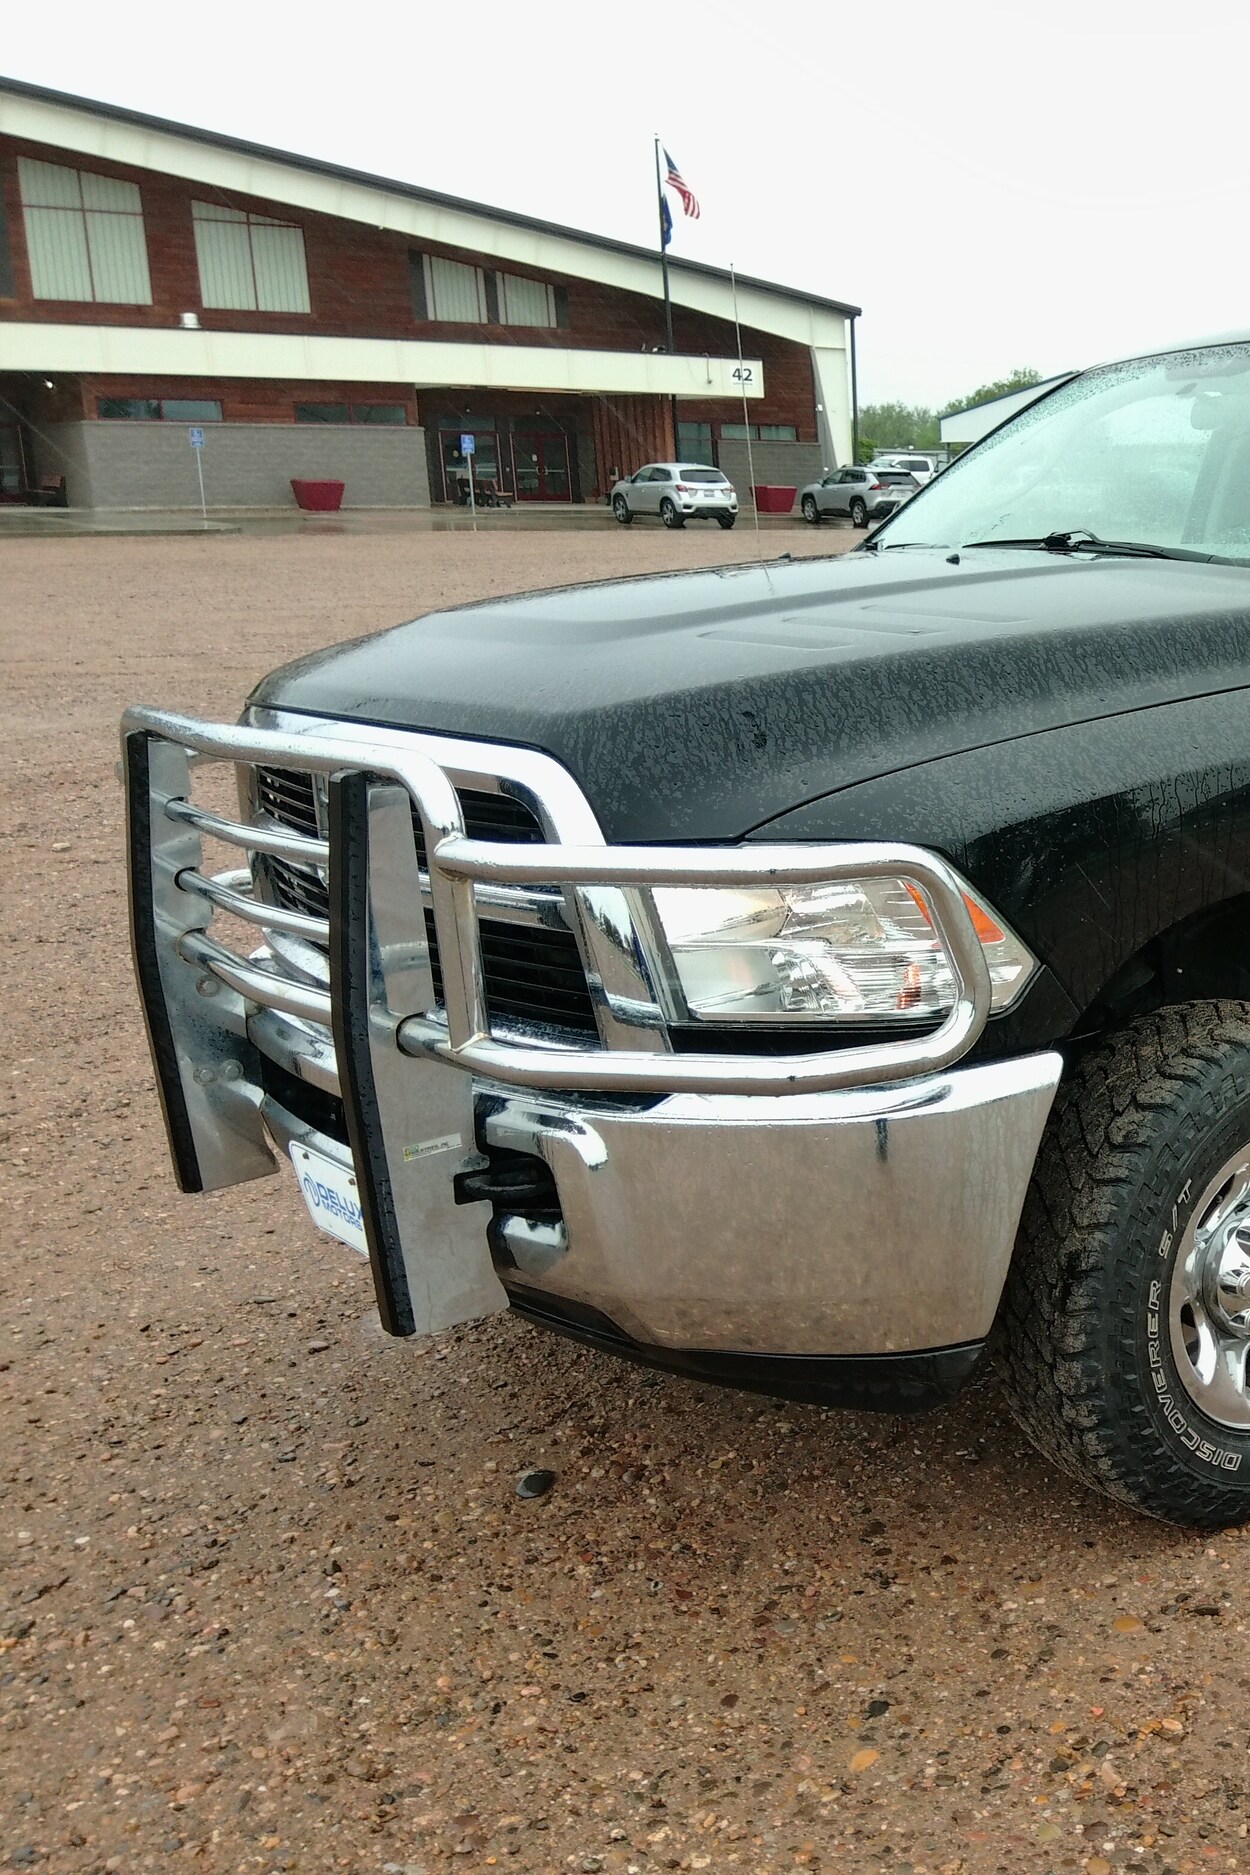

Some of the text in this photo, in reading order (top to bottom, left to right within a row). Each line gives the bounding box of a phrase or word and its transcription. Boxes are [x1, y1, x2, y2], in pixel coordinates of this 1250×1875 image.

[732, 368, 753, 381] 42
[321, 1199, 363, 1231] MOTORS
[1147, 1280, 1242, 1471] DISCOVERER
